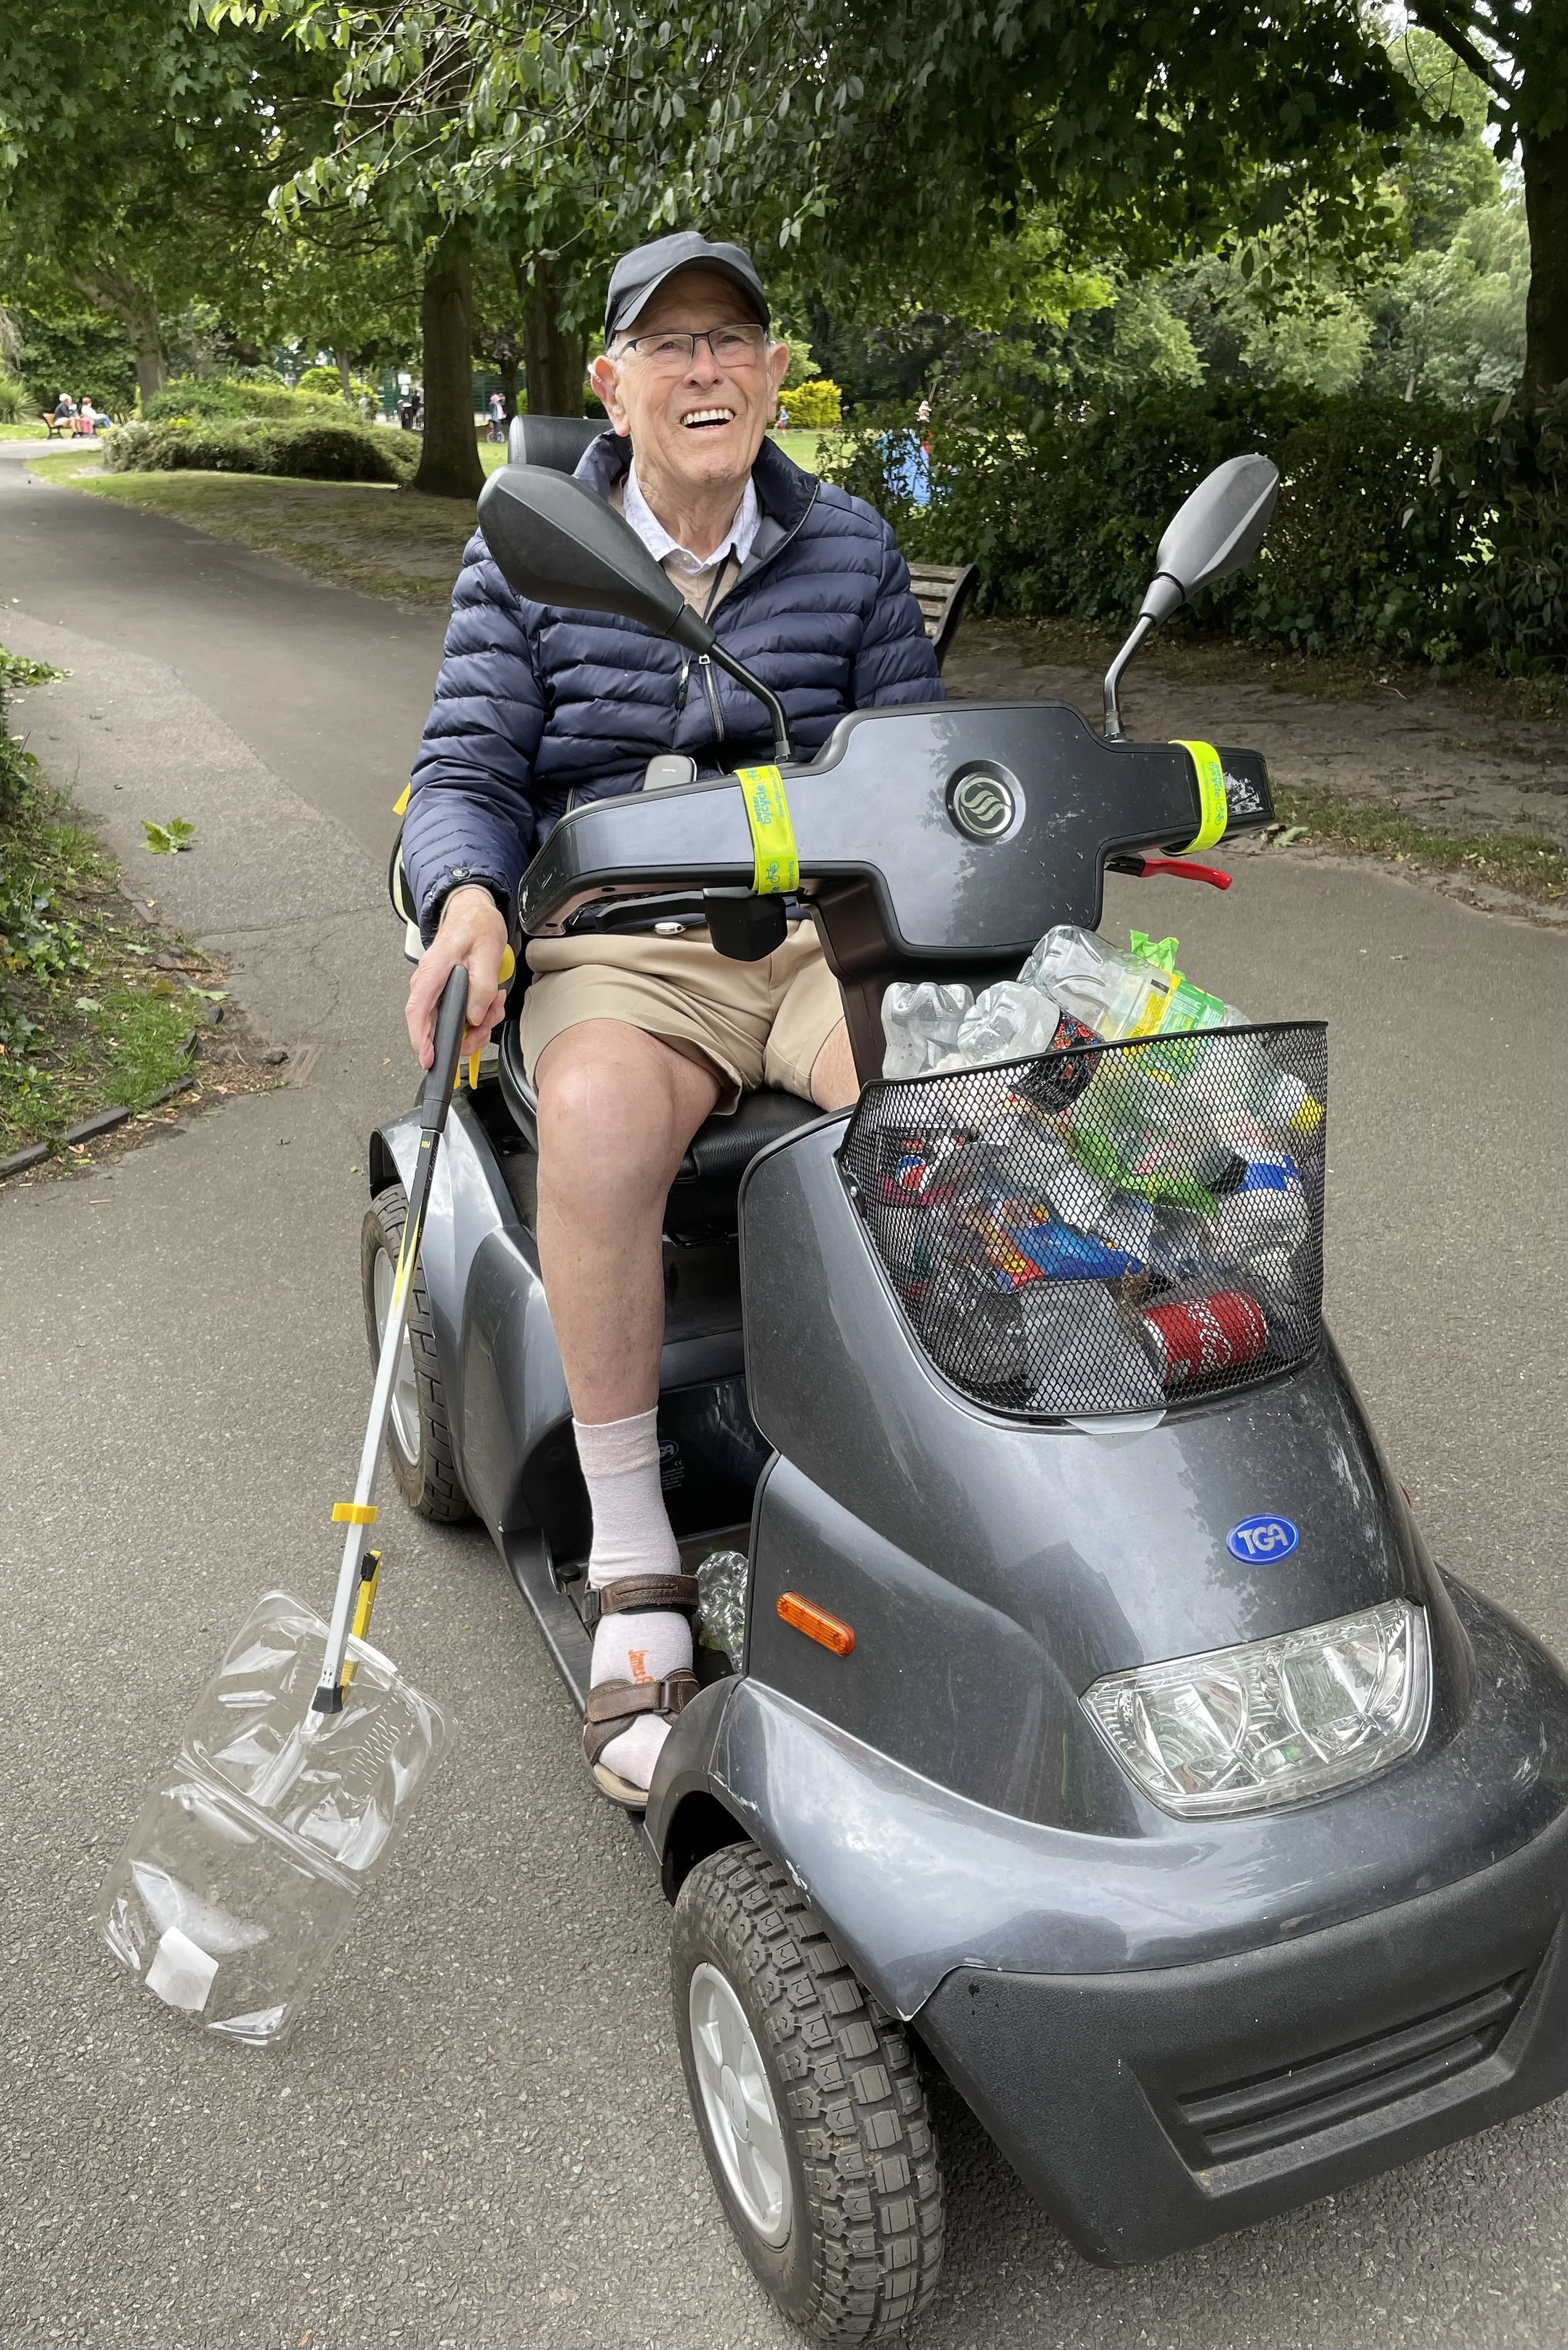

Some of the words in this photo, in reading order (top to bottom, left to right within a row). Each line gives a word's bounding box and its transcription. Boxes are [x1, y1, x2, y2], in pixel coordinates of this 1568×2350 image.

[1209, 762, 1221, 798] bycycle
[753, 796, 763, 822] better
[757, 785, 773, 824] bycycle
[660, 1445, 674, 1457] GA
[1237, 1524, 1288, 1555] TGA
[628, 1650, 649, 1677] James
